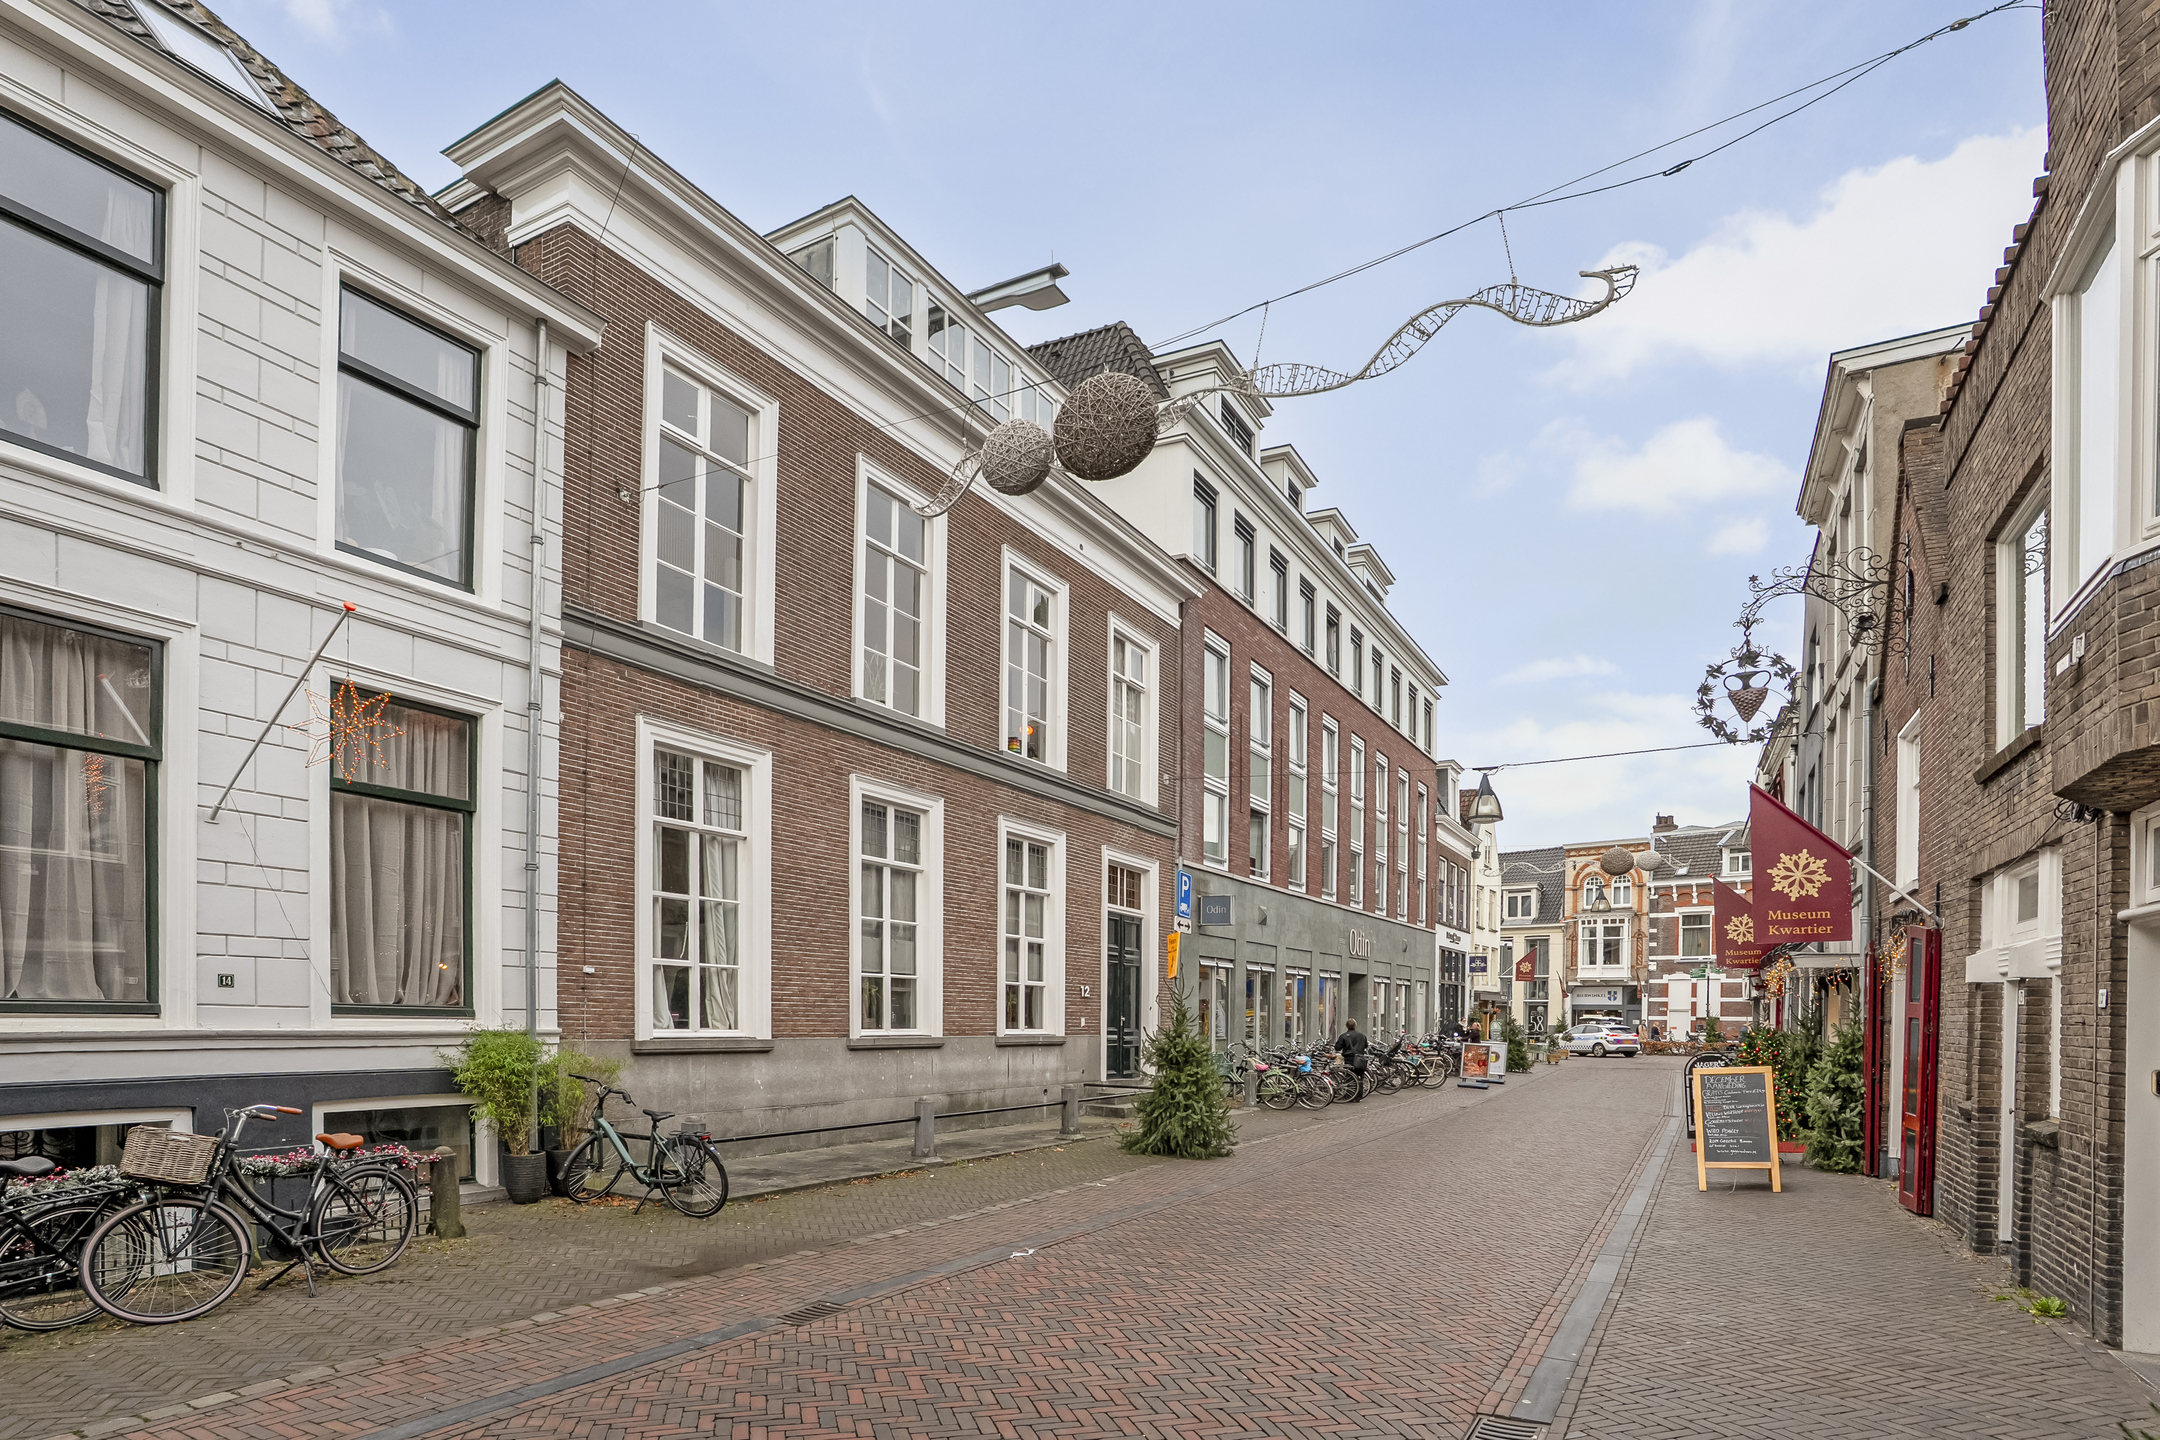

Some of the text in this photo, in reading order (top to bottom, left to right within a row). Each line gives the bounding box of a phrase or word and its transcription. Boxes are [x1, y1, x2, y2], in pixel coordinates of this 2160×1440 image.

[1181, 875, 1190, 898] P
[1206, 905, 1227, 914] Odin
[1767, 909, 1831, 921] Museum
[1767, 923, 1833, 936] Kwartier
[1349, 928, 1371, 958] Odin
[221, 976, 232, 986] 14
[1080, 985, 1091, 997] 12
[1530, 1015, 1544, 1032] 58
